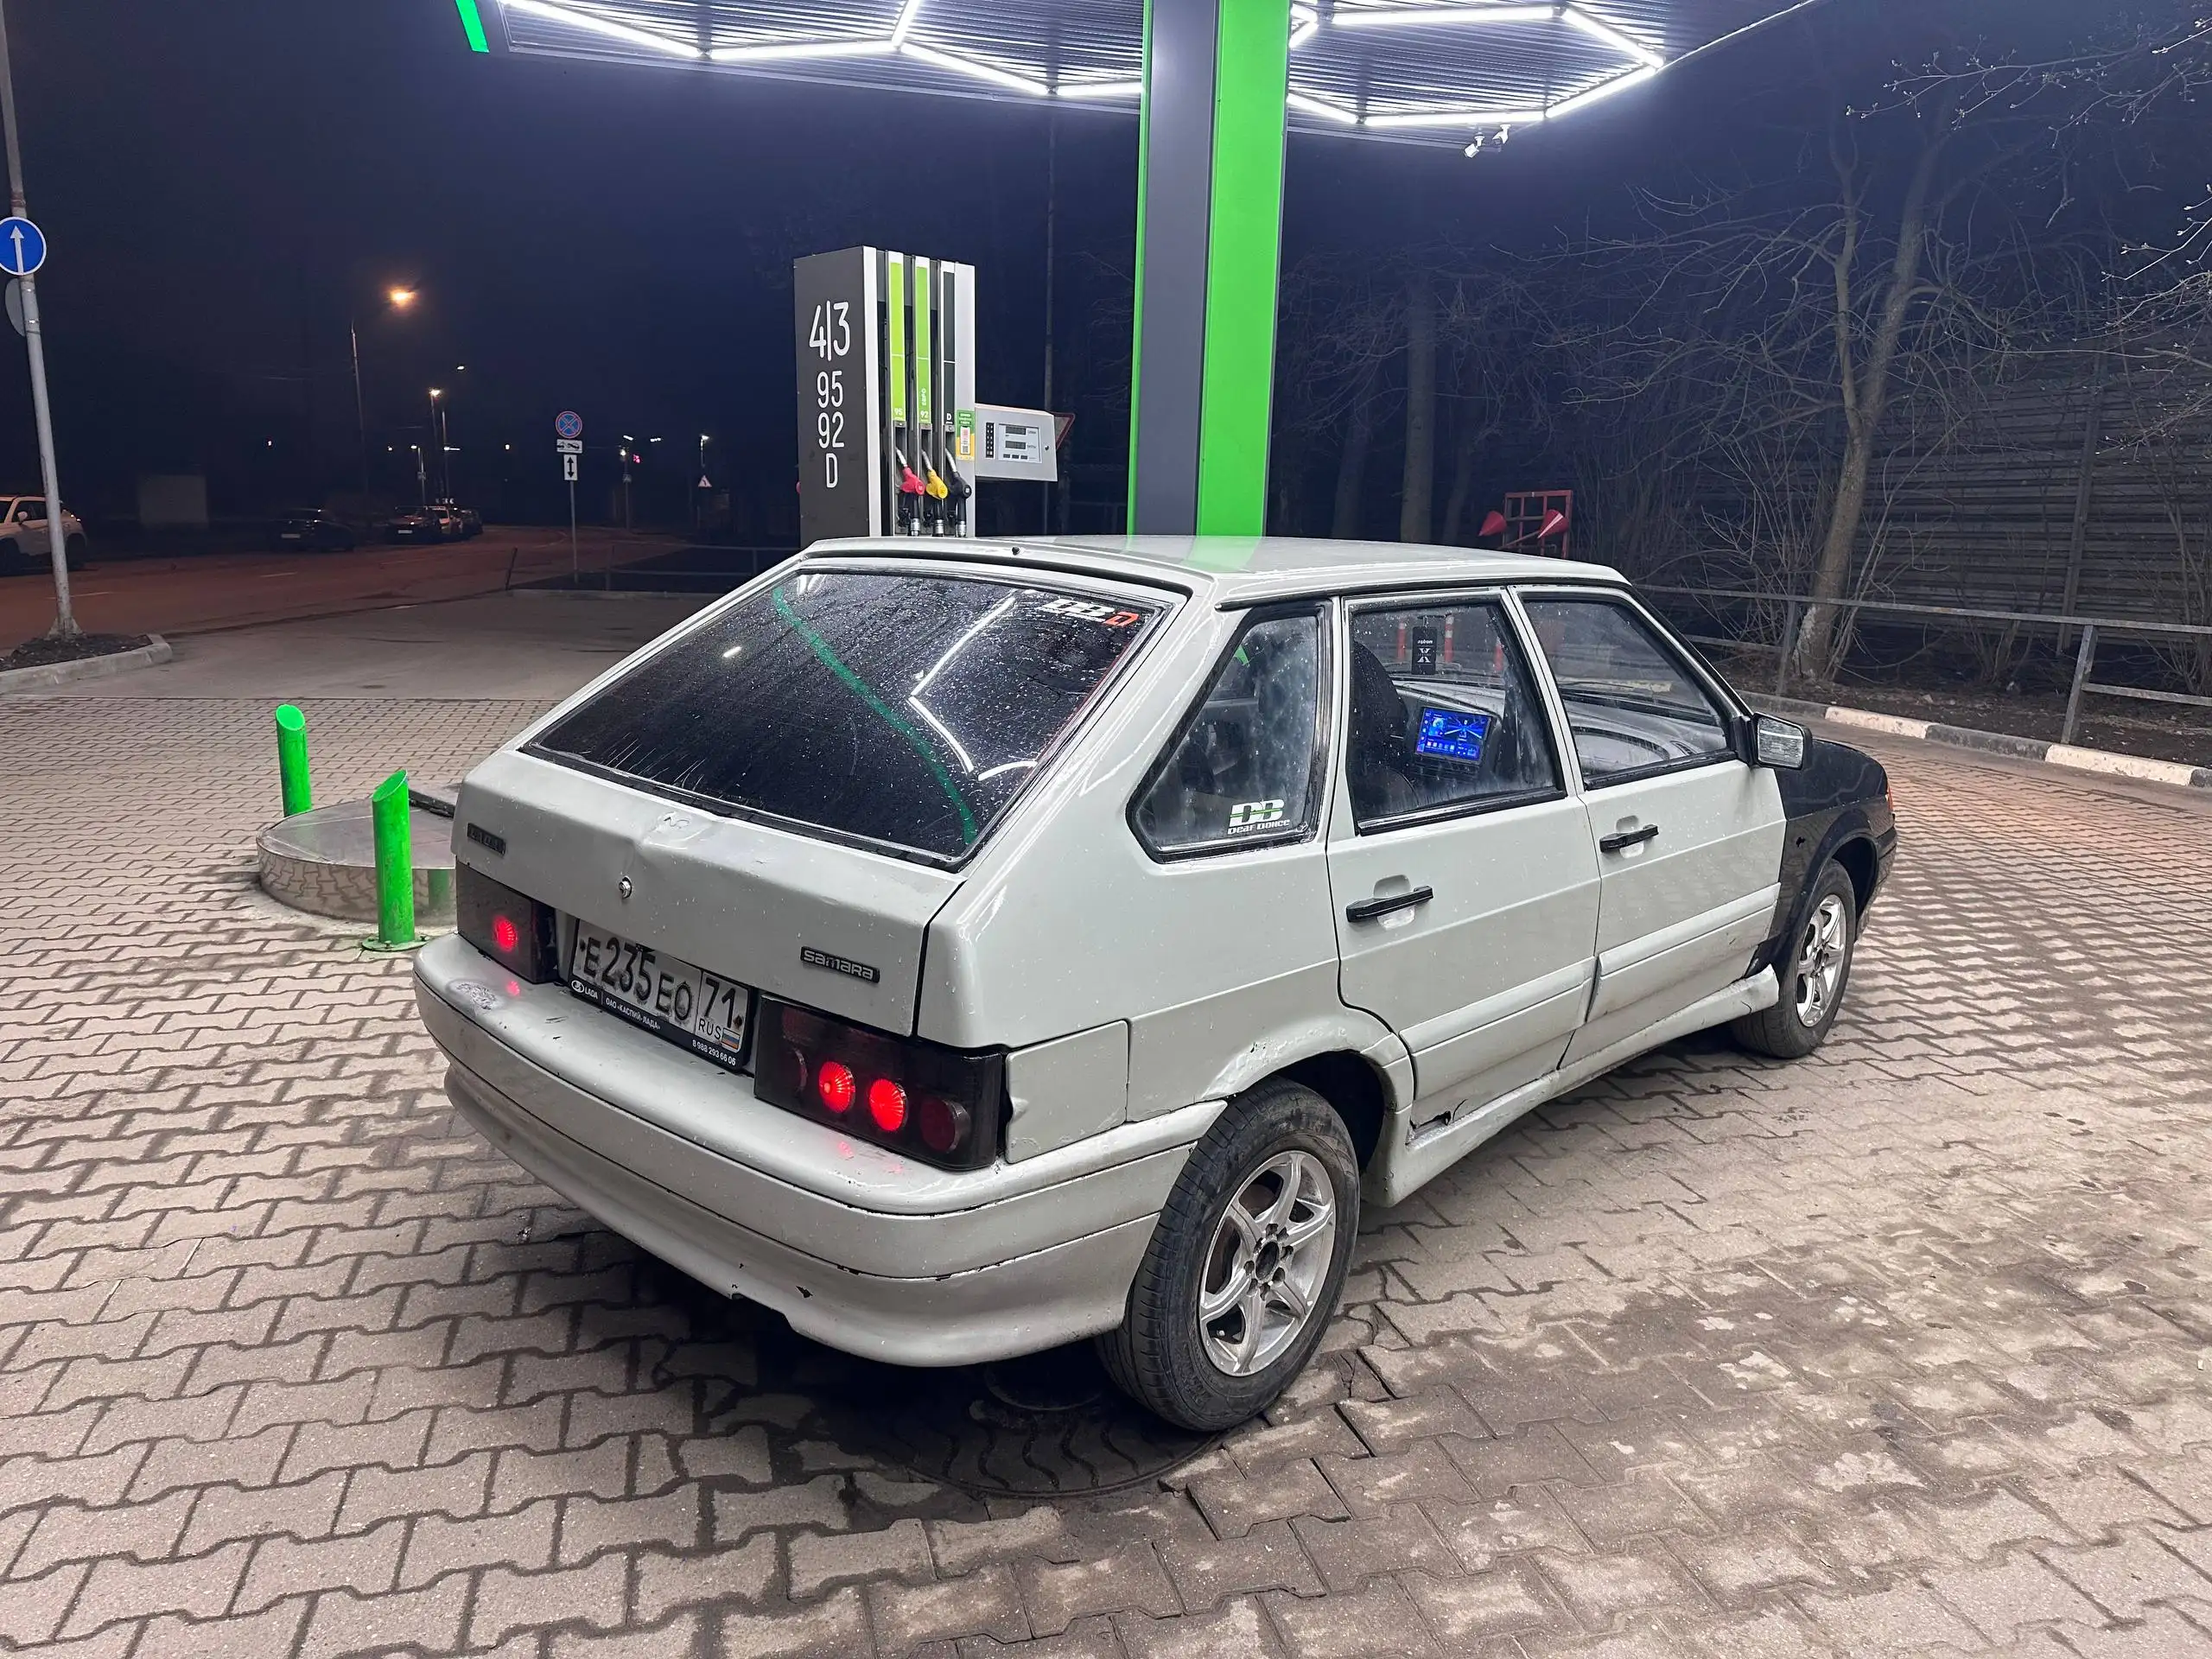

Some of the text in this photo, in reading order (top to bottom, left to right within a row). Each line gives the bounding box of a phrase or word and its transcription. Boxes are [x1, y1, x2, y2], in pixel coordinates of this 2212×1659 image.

[817, 370, 843, 408] 95
[818, 411, 844, 448] 92
[826, 453, 838, 488] D
[1230, 799, 1285, 827] DB
[585, 987, 598, 1000] LADA
[606, 997, 617, 1009] ОАО
[704, 978, 736, 1028] 71
[698, 1018, 721, 1040] RUS
[692, 1039, 736, 1066] 8 988 293 66 06
